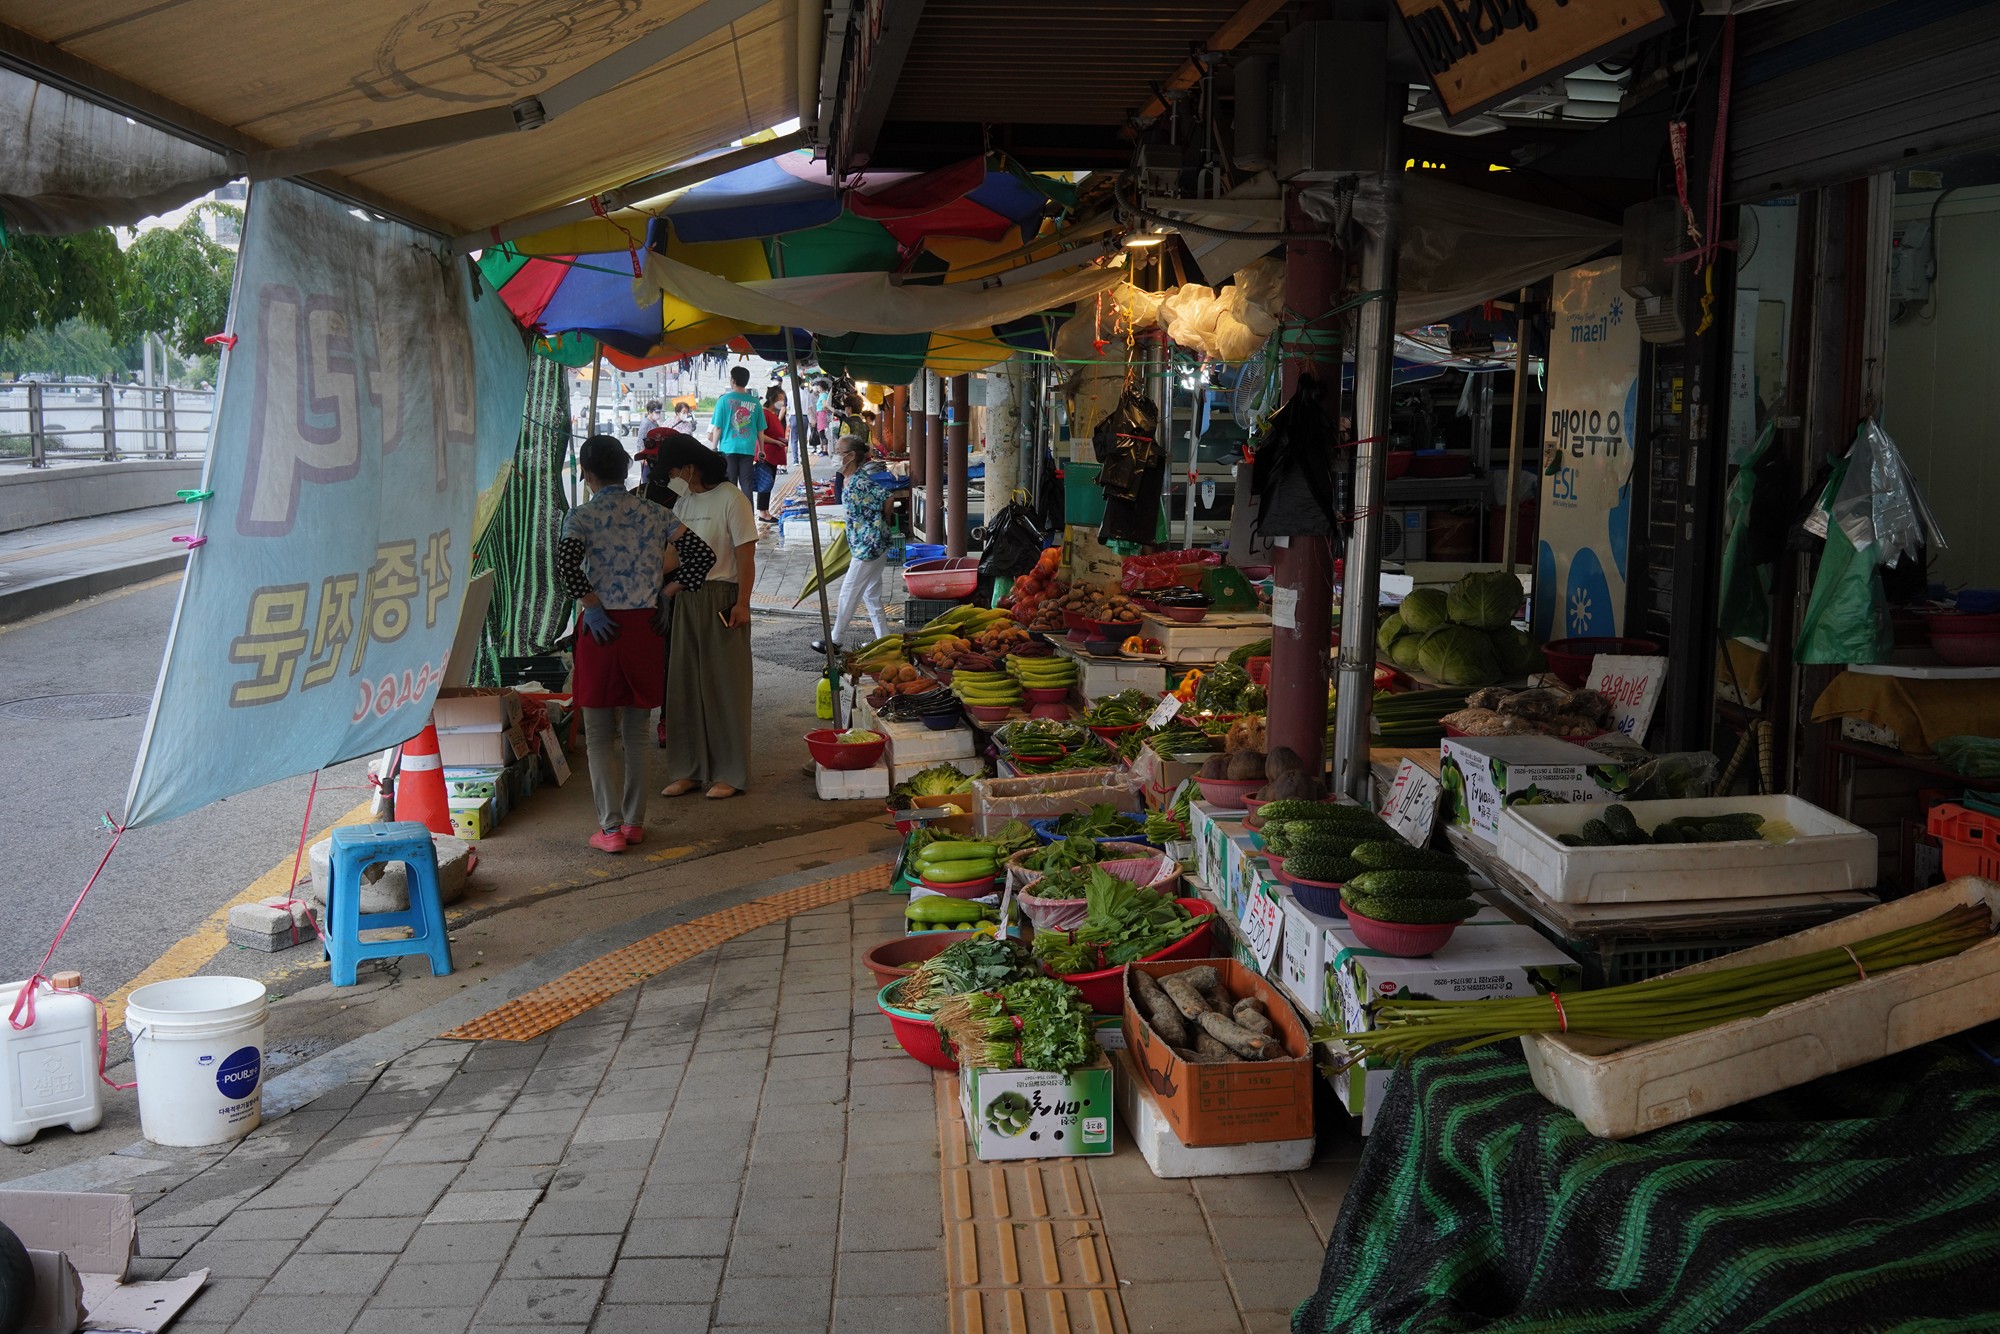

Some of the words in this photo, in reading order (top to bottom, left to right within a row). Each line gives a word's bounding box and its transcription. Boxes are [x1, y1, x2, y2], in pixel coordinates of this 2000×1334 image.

[1571, 317, 1607, 343] maeil
[1552, 409, 1622, 459] 매일우유
[1553, 467, 1577, 500] ESL
[1029, 1089, 1081, 1116] 매실
[1061, 1116, 1078, 1126] 순천
